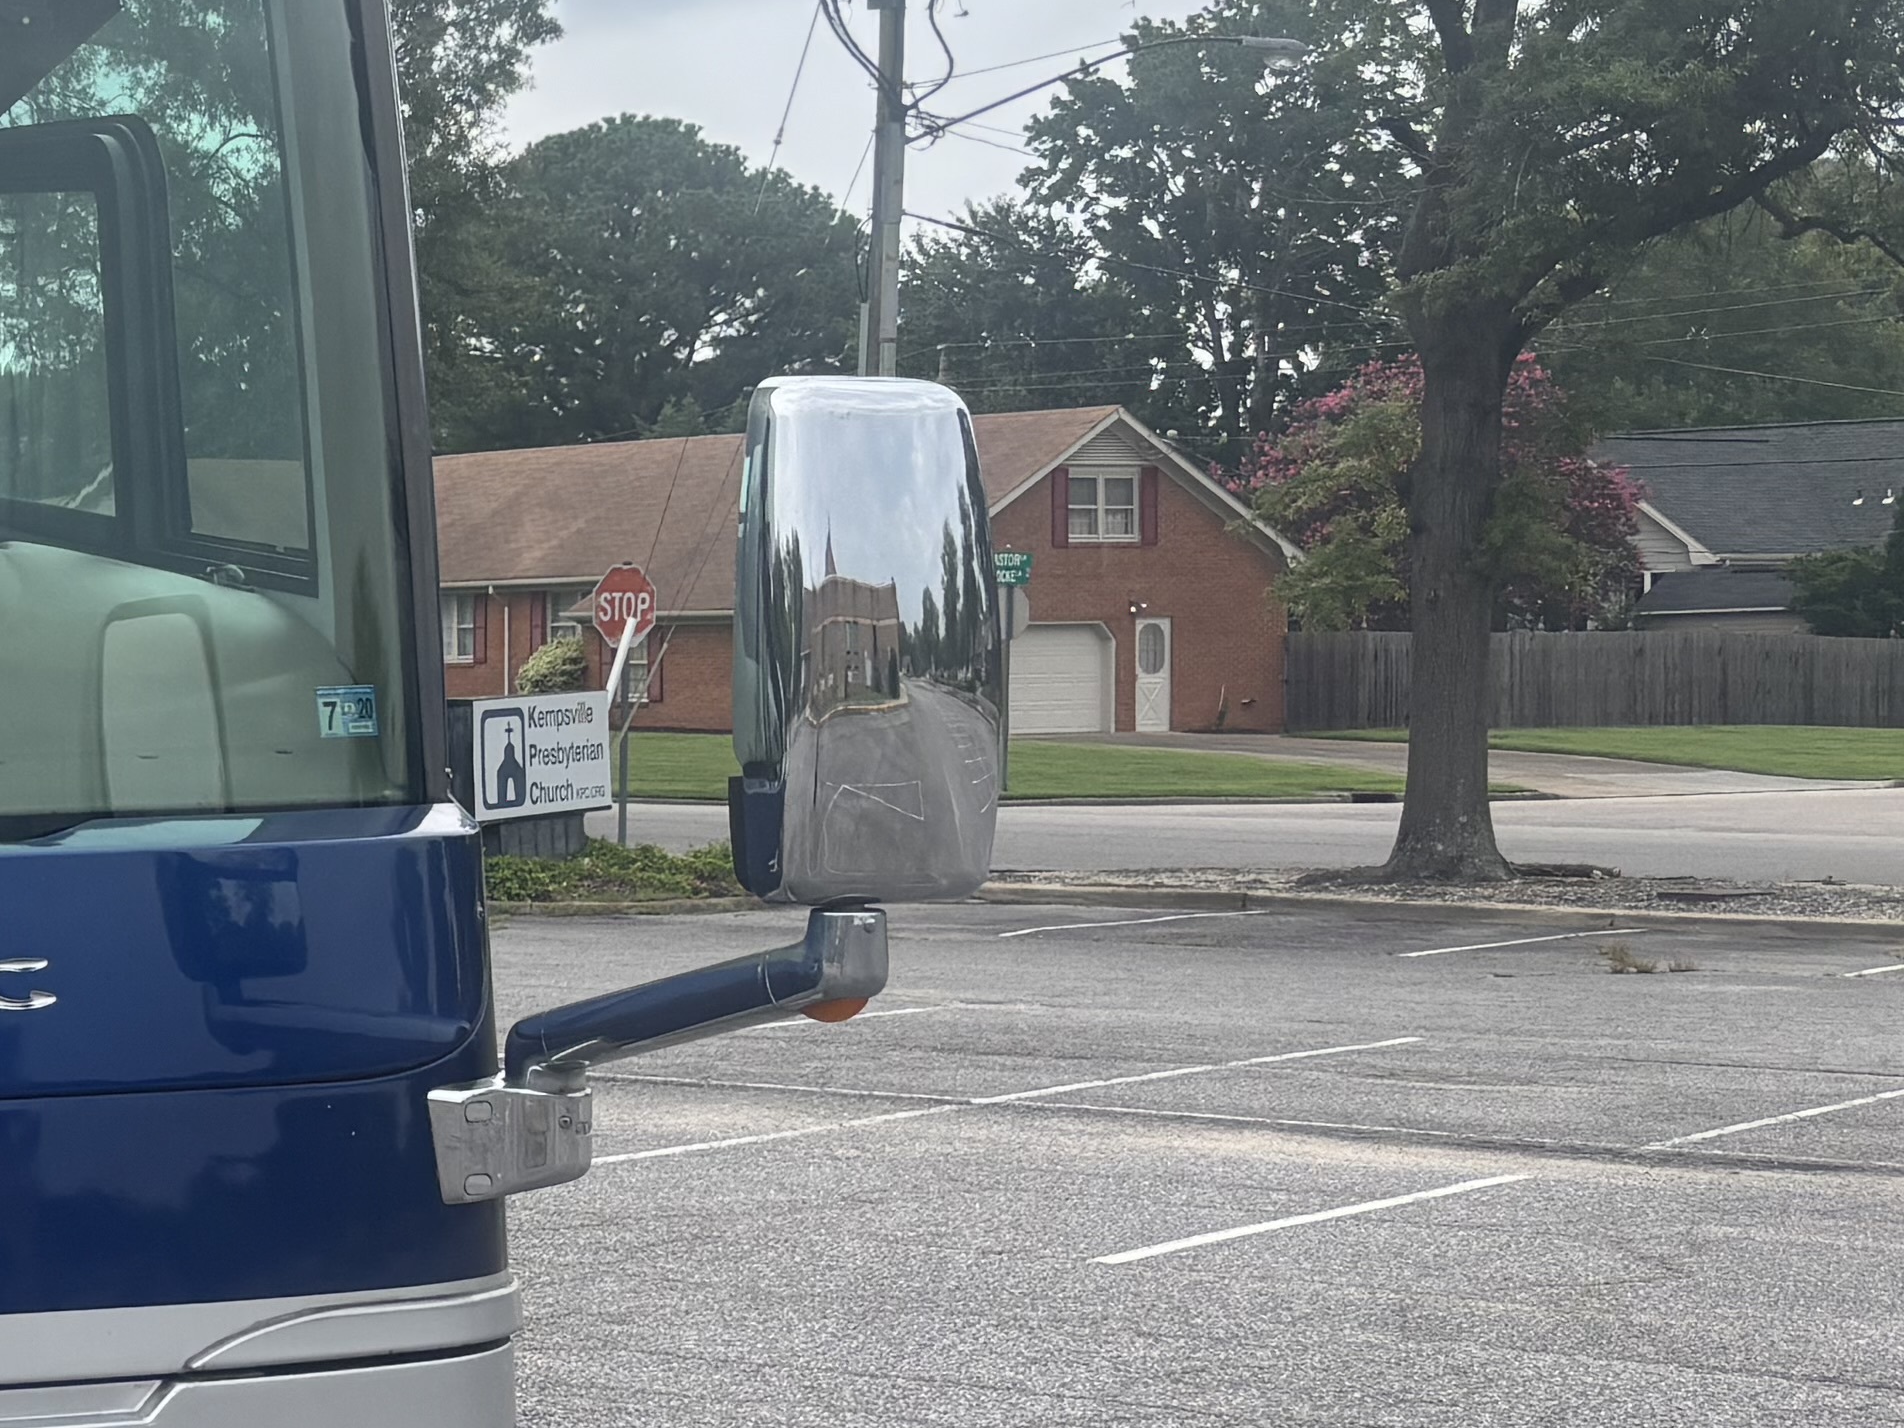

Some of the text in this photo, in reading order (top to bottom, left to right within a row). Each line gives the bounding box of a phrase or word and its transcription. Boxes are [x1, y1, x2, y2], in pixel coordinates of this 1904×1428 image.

[599, 592, 650, 622] STOP
[322, 701, 337, 731] 7
[528, 701, 593, 732] Kempsville
[529, 738, 604, 769] Presbyterian
[529, 778, 574, 805] Church
